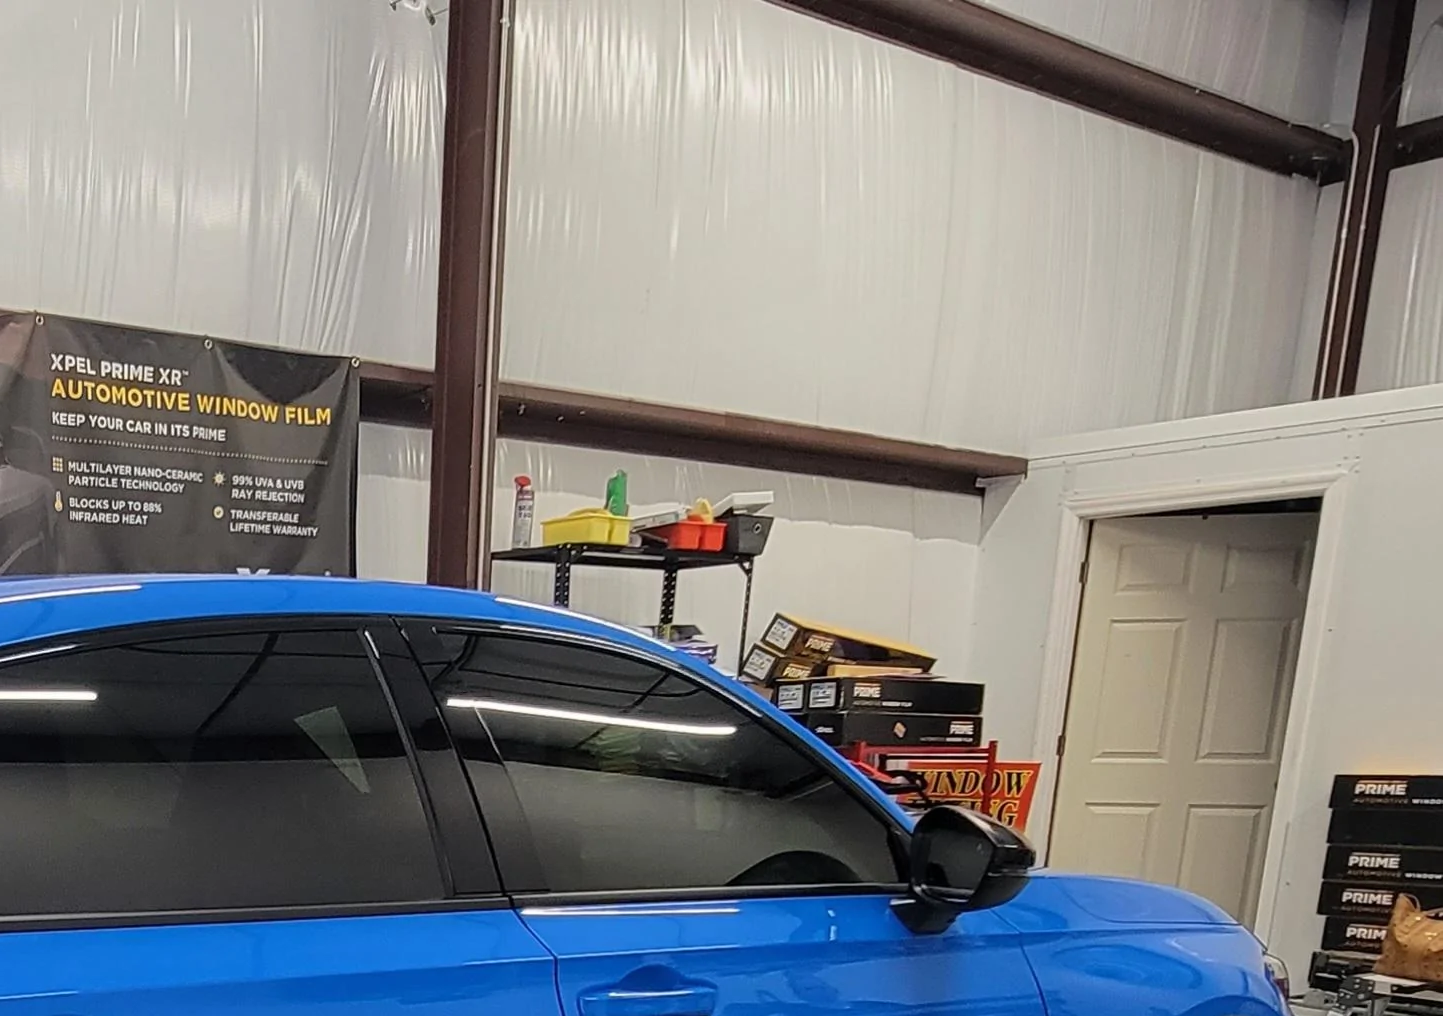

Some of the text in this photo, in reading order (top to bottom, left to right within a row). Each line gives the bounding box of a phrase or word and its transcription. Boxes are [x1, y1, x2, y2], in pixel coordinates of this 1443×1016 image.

[50, 354, 96, 375] XPEL
[100, 361, 154, 383] PRIME
[51, 378, 331, 426] AUTOMOTIVE WINDOW FILM
[52, 411, 226, 442] KEEP YOUR CAR IN ITS PRIME
[68, 461, 204, 483] MULTILAYER NANO-CERAMIC
[68, 475, 185, 493] PARTICLE TECHNOLOGY
[232, 475, 304, 490] 99% UVA & UVB
[231, 489, 305, 503] RAY REJECTION
[69, 498, 109, 510] BLOCKS
[112, 500, 126, 510] UP
[128, 501, 142, 511] TO
[69, 511, 148, 525] INFRARED HEAT
[230, 509, 299, 523] TRANSFERABLE
[230, 522, 318, 537] LIFETIME WARRANTY
[916, 769, 1033, 797] INDOW
[1354, 784, 1408, 795] PRIME
[1347, 856, 1401, 869] PRIME
[1341, 891, 1394, 905] PRIME
[1346, 927, 1388, 940] PRIM
